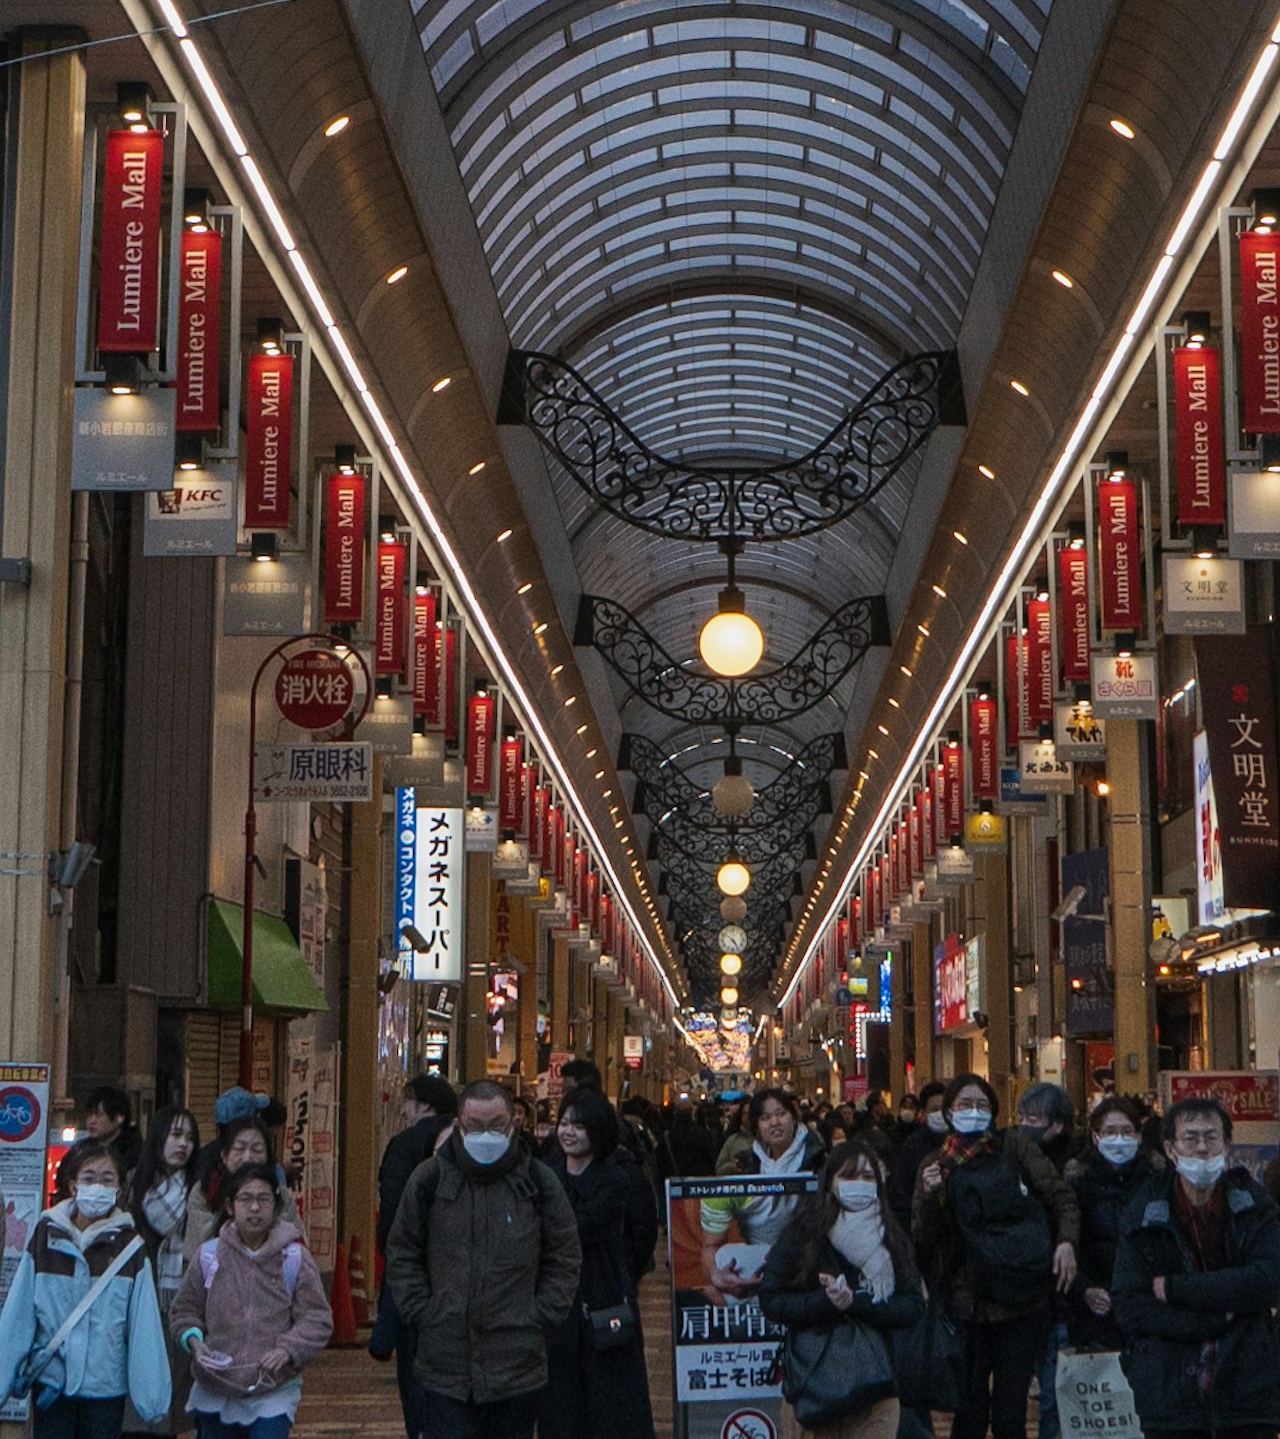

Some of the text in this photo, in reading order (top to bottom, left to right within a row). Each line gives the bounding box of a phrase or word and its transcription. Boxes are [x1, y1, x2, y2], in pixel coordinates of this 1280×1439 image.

[117, 151, 148, 331] Lumiere Mall
[182, 249, 208, 413] Lumiere Mall
[1255, 251, 1280, 415] Lumiere Mall
[258, 371, 281, 513] Lumiere Mall
[1187, 364, 1210, 508] Lumiere Mall
[185, 489, 223, 502] KFC
[336, 488, 355, 608] Lumiere Mall
[378, 553, 397, 662] Lumiere Mall
[1109, 495, 1129, 615] Lumiere Mall
[1180, 579, 1229, 595] 文明堂
[414, 605, 428, 637] Mall
[1069, 560, 1089, 668] Lumiere Mall
[281, 674, 349, 705] 消火栓
[1115, 661, 1134, 679] 靴
[289, 747, 367, 781] 原眼科
[1227, 712, 1271, 828] 文明堂
[427, 812, 453, 969] メガネスーパー
[1239, 1091, 1273, 1108] SALE
[1070, 1412, 1134, 1429] SHOES!
[1076, 1381, 1111, 1395] ONE
[1080, 1400, 1115, 1413] TOE
